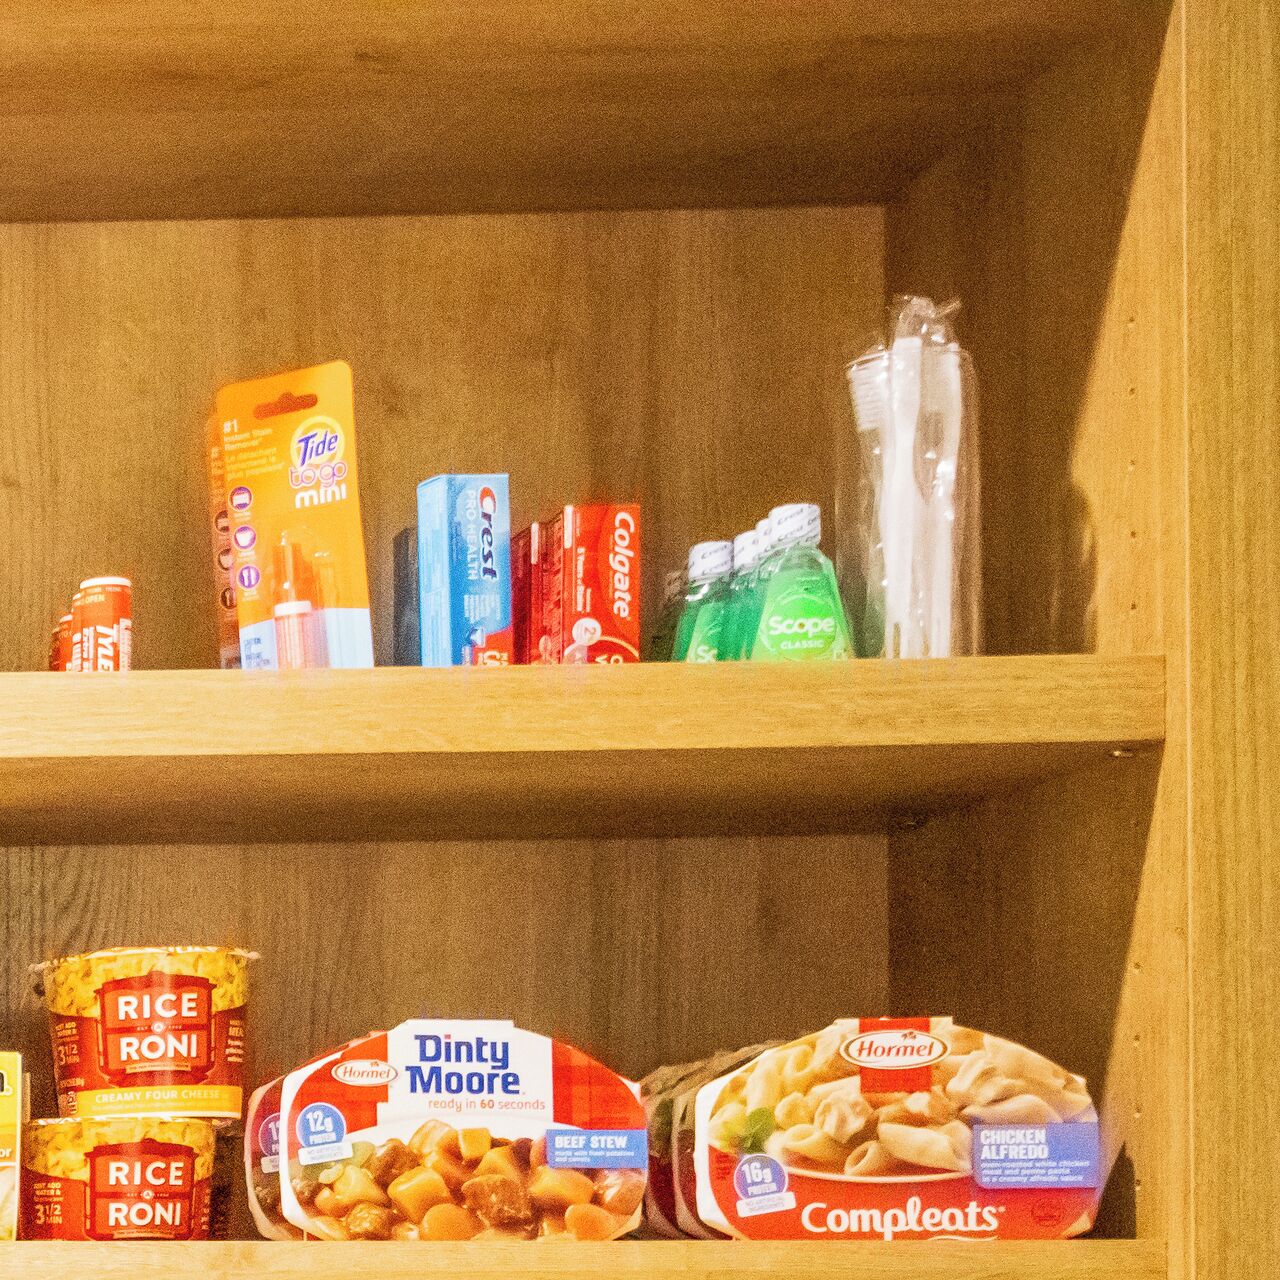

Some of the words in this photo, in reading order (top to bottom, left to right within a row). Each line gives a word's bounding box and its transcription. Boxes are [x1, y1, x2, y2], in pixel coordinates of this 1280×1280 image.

[297, 430, 339, 467] Tide
[289, 466, 317, 488] to
[319, 461, 348, 488] go
[294, 482, 348, 509] mini
[479, 486, 499, 581] Crest
[608, 512, 634, 618] Colgate
[768, 615, 834, 635] Scope
[780, 638, 824, 650] CLASSIC
[117, 992, 198, 1021] RICE
[119, 1033, 198, 1062] RONI
[413, 1033, 510, 1070] Dinty
[857, 1037, 936, 1059] Hormel
[342, 1064, 392, 1081] Hormel
[405, 1065, 521, 1096] Moore
[95, 1091, 142, 1104] CREAMY
[145, 1089, 178, 1101] FOUR
[181, 1088, 221, 1100] CHEESE
[427, 1098, 462, 1111] ready
[463, 1098, 477, 1109] in
[479, 1098, 495, 1109] 60
[497, 1098, 547, 1110] seconds
[307, 1111, 334, 1134] 12g
[554, 1135, 587, 1149] BEEF
[589, 1135, 629, 1149] STEW
[979, 1129, 1047, 1145] CHICKEN
[979, 1143, 1050, 1160] ALFREDO
[108, 1160, 184, 1186] RICE
[741, 1162, 773, 1185] 16g
[107, 1201, 182, 1227] RONI
[801, 1197, 997, 1241] Compleats
